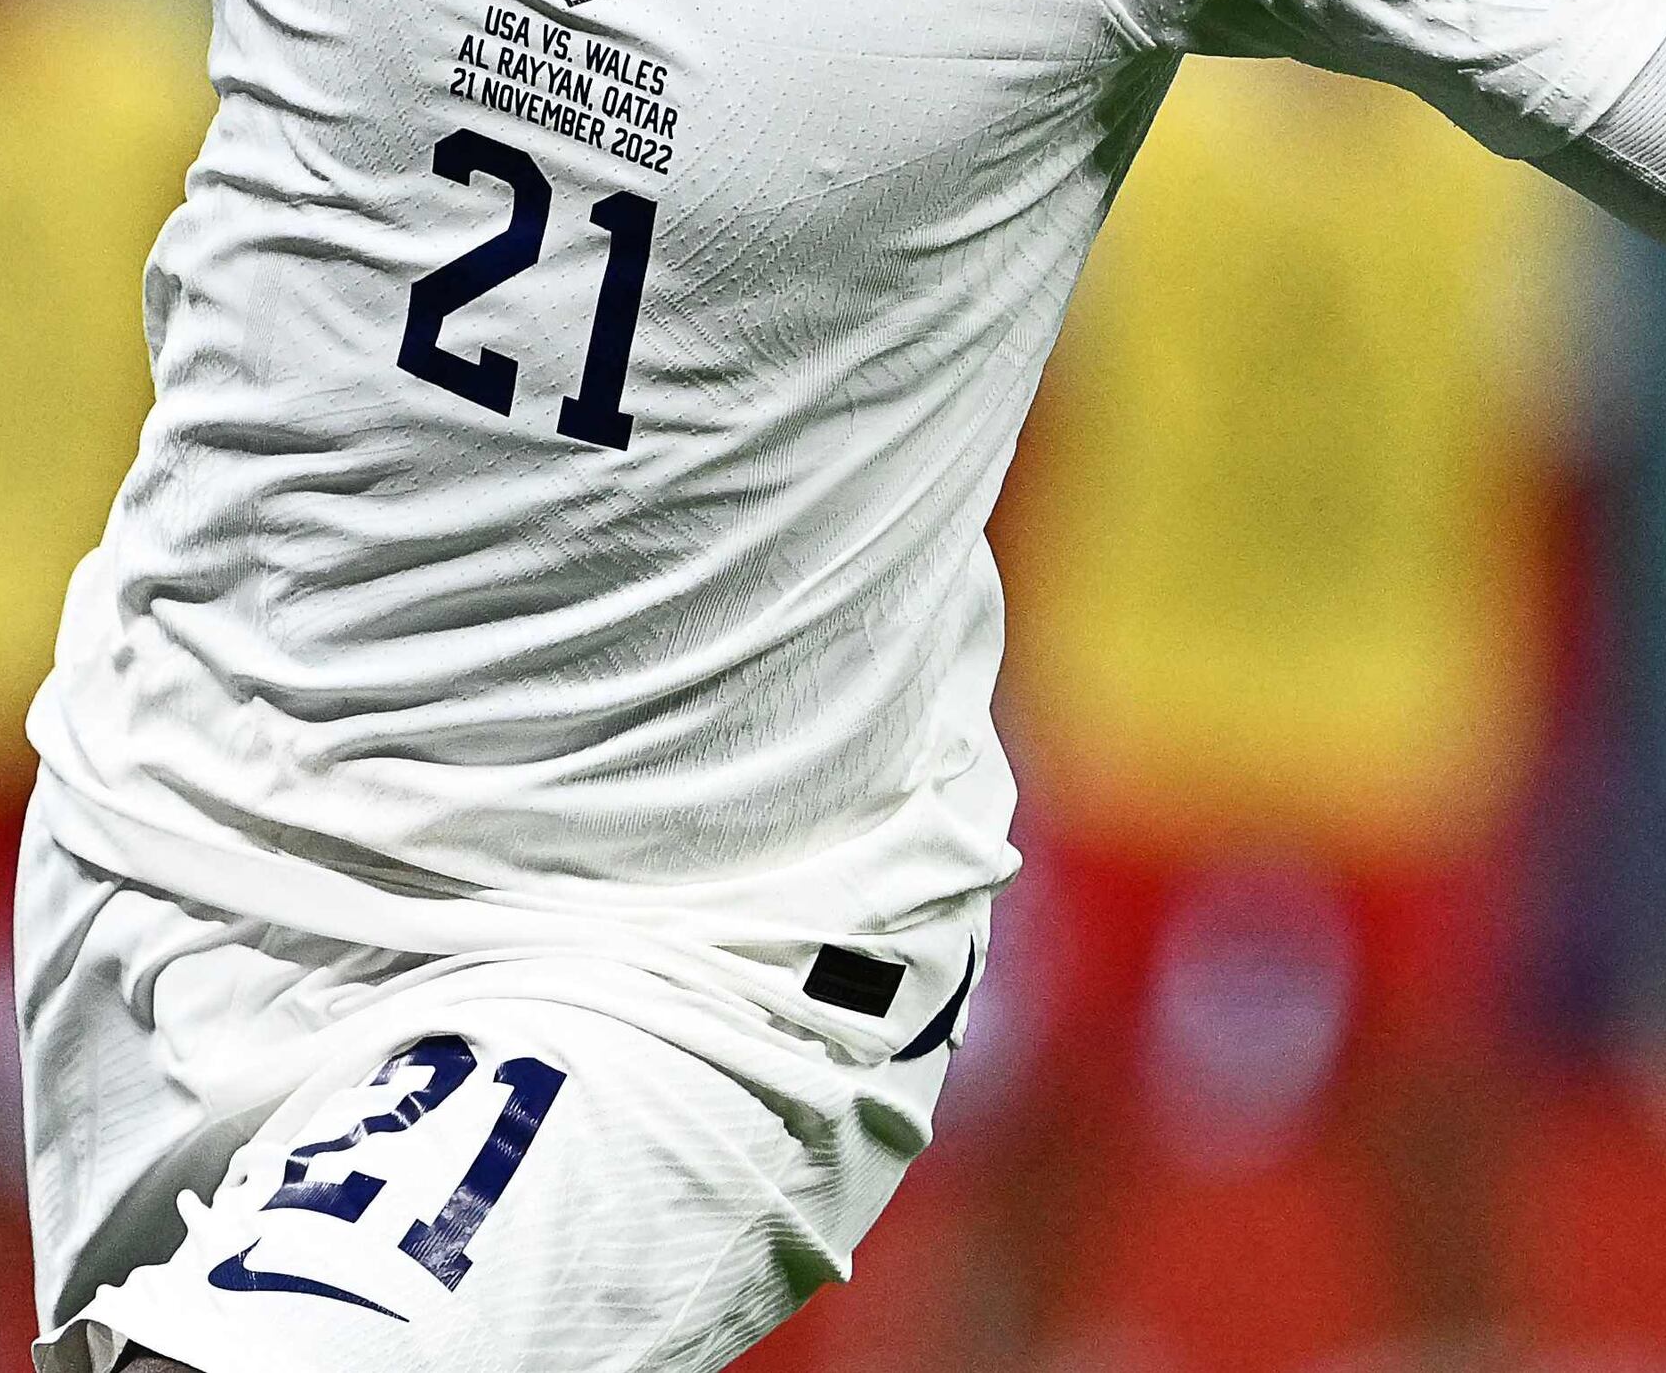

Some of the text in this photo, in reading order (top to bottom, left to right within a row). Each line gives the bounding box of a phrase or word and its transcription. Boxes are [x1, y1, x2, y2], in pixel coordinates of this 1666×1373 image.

[458, 34, 678, 140] AL RAYYAN, QATAR
[485, 5, 668, 96] USA VS. WALES
[449, 67, 673, 176] 21 NOVEMBER 2022
[396, 128, 658, 451] 21
[259, 1033, 568, 1293] 21
